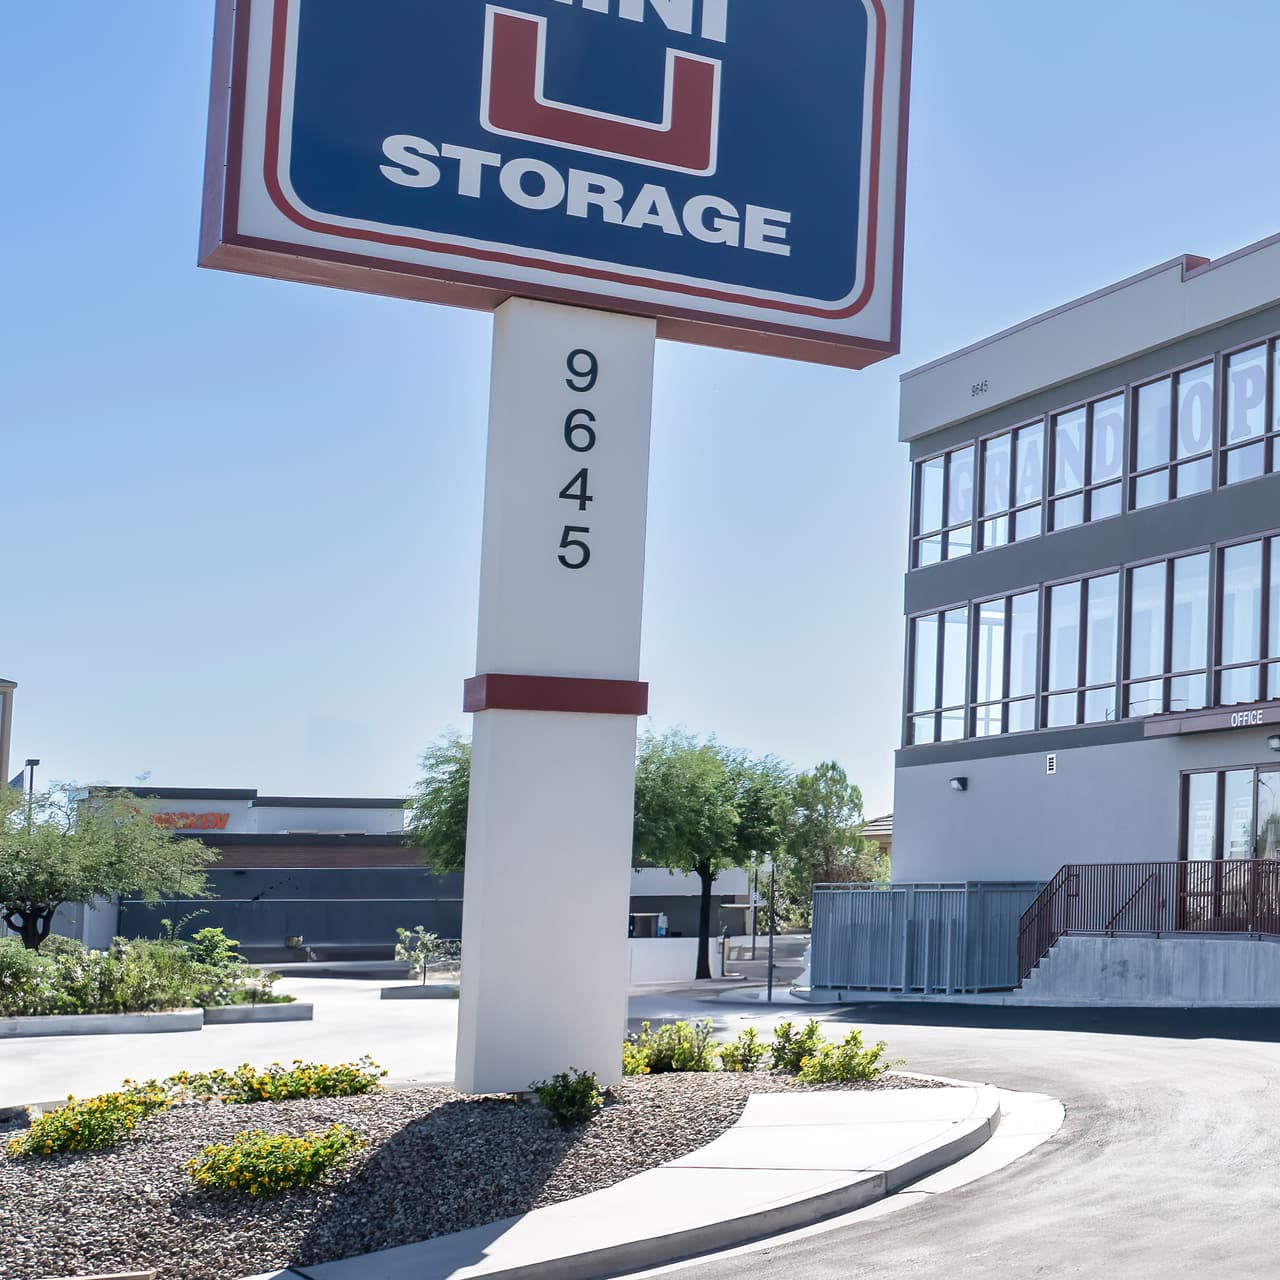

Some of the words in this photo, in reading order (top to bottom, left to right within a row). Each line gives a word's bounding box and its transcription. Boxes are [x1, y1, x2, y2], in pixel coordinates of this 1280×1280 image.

[479, 3, 722, 177] U
[379, 134, 791, 256] STORAGE
[970, 379, 989, 397] 9645
[557, 348, 599, 570] 9645
[949, 411, 1123, 521] GRAND
[1231, 710, 1264, 727] OFFICE
